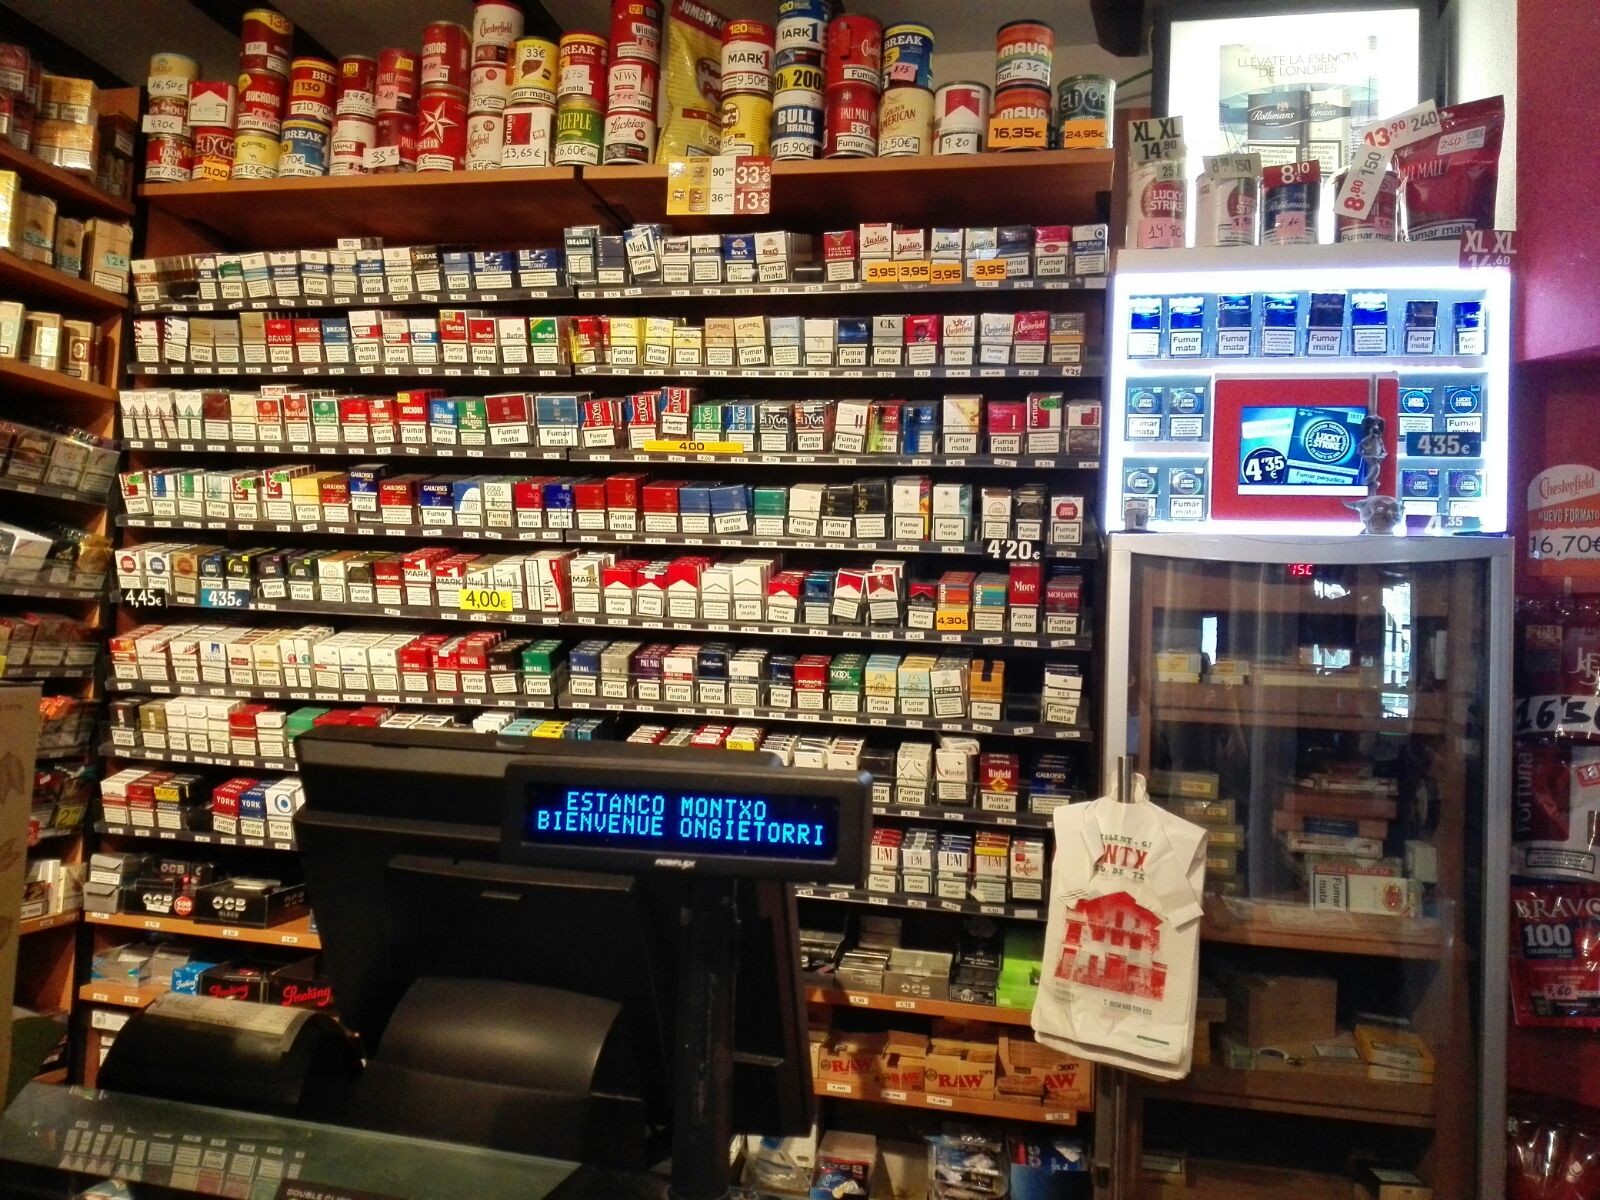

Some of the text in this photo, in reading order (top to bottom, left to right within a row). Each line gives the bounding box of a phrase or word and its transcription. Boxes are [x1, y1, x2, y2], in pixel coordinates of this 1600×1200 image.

[729, 23, 748, 34] 120
[884, 35, 923, 46] BREAK
[561, 45, 596, 56] BREAK
[728, 52, 763, 65] MARK
[1279, 63, 1337, 77] LONDRES
[614, 72, 637, 82] NEWS
[793, 69, 821, 90] 200
[300, 82, 321, 93] 130
[246, 90, 280, 108] DUCADOS
[778, 108, 815, 126] BULL
[1252, 110, 1296, 122] Rothmans
[1410, 111, 1438, 132] 240
[786, 124, 815, 134] BRAND
[994, 127, 1043, 140] 16,35€
[1133, 118, 1182, 142] XL XL
[285, 130, 322, 143] BREAK
[712, 167, 725, 177] 90
[711, 193, 724, 203] 36
[1152, 189, 1183, 200] LUCKY
[1150, 200, 1184, 212] STRIKE
[1463, 229, 1518, 254] XL XL
[1038, 258, 1065, 266] Fumar
[760, 264, 785, 272] Fumar
[868, 267, 897, 277] 3,95
[901, 266, 928, 276] 3,95
[976, 265, 1005, 275] 3,95
[1041, 266, 1062, 274] mata
[932, 270, 961, 281] 3,95
[880, 319, 896, 329] CK
[1173, 336, 1199, 344] Fumar
[1220, 335, 1248, 343] Fumar
[1311, 334, 1338, 343] Fumar
[841, 348, 865, 357] Fumar
[1175, 344, 1197, 352] mata
[843, 356, 862, 364] mata
[679, 442, 705, 451] 400
[1539, 472, 1595, 499] Chesterfield
[1564, 508, 1600, 522] FORMATO
[1014, 583, 1036, 592] More
[466, 591, 507, 609] 4,00€
[937, 617, 967, 626] 4,30€
[1516, 752, 1534, 832] Fortuna
[216, 795, 236, 806] YORK
[242, 799, 261, 809] YORK
[567, 791, 766, 820] ESTANCO MONTXO
[537, 810, 824, 846] BIENVENUE ONGIETORRI
[212, 896, 247, 911] OCB
[1524, 924, 1572, 948] 100
[901, 983, 931, 995] OCB
[831, 1059, 872, 1073] RAW
[939, 1072, 985, 1088] RAW
[1044, 1074, 1076, 1090] AW
